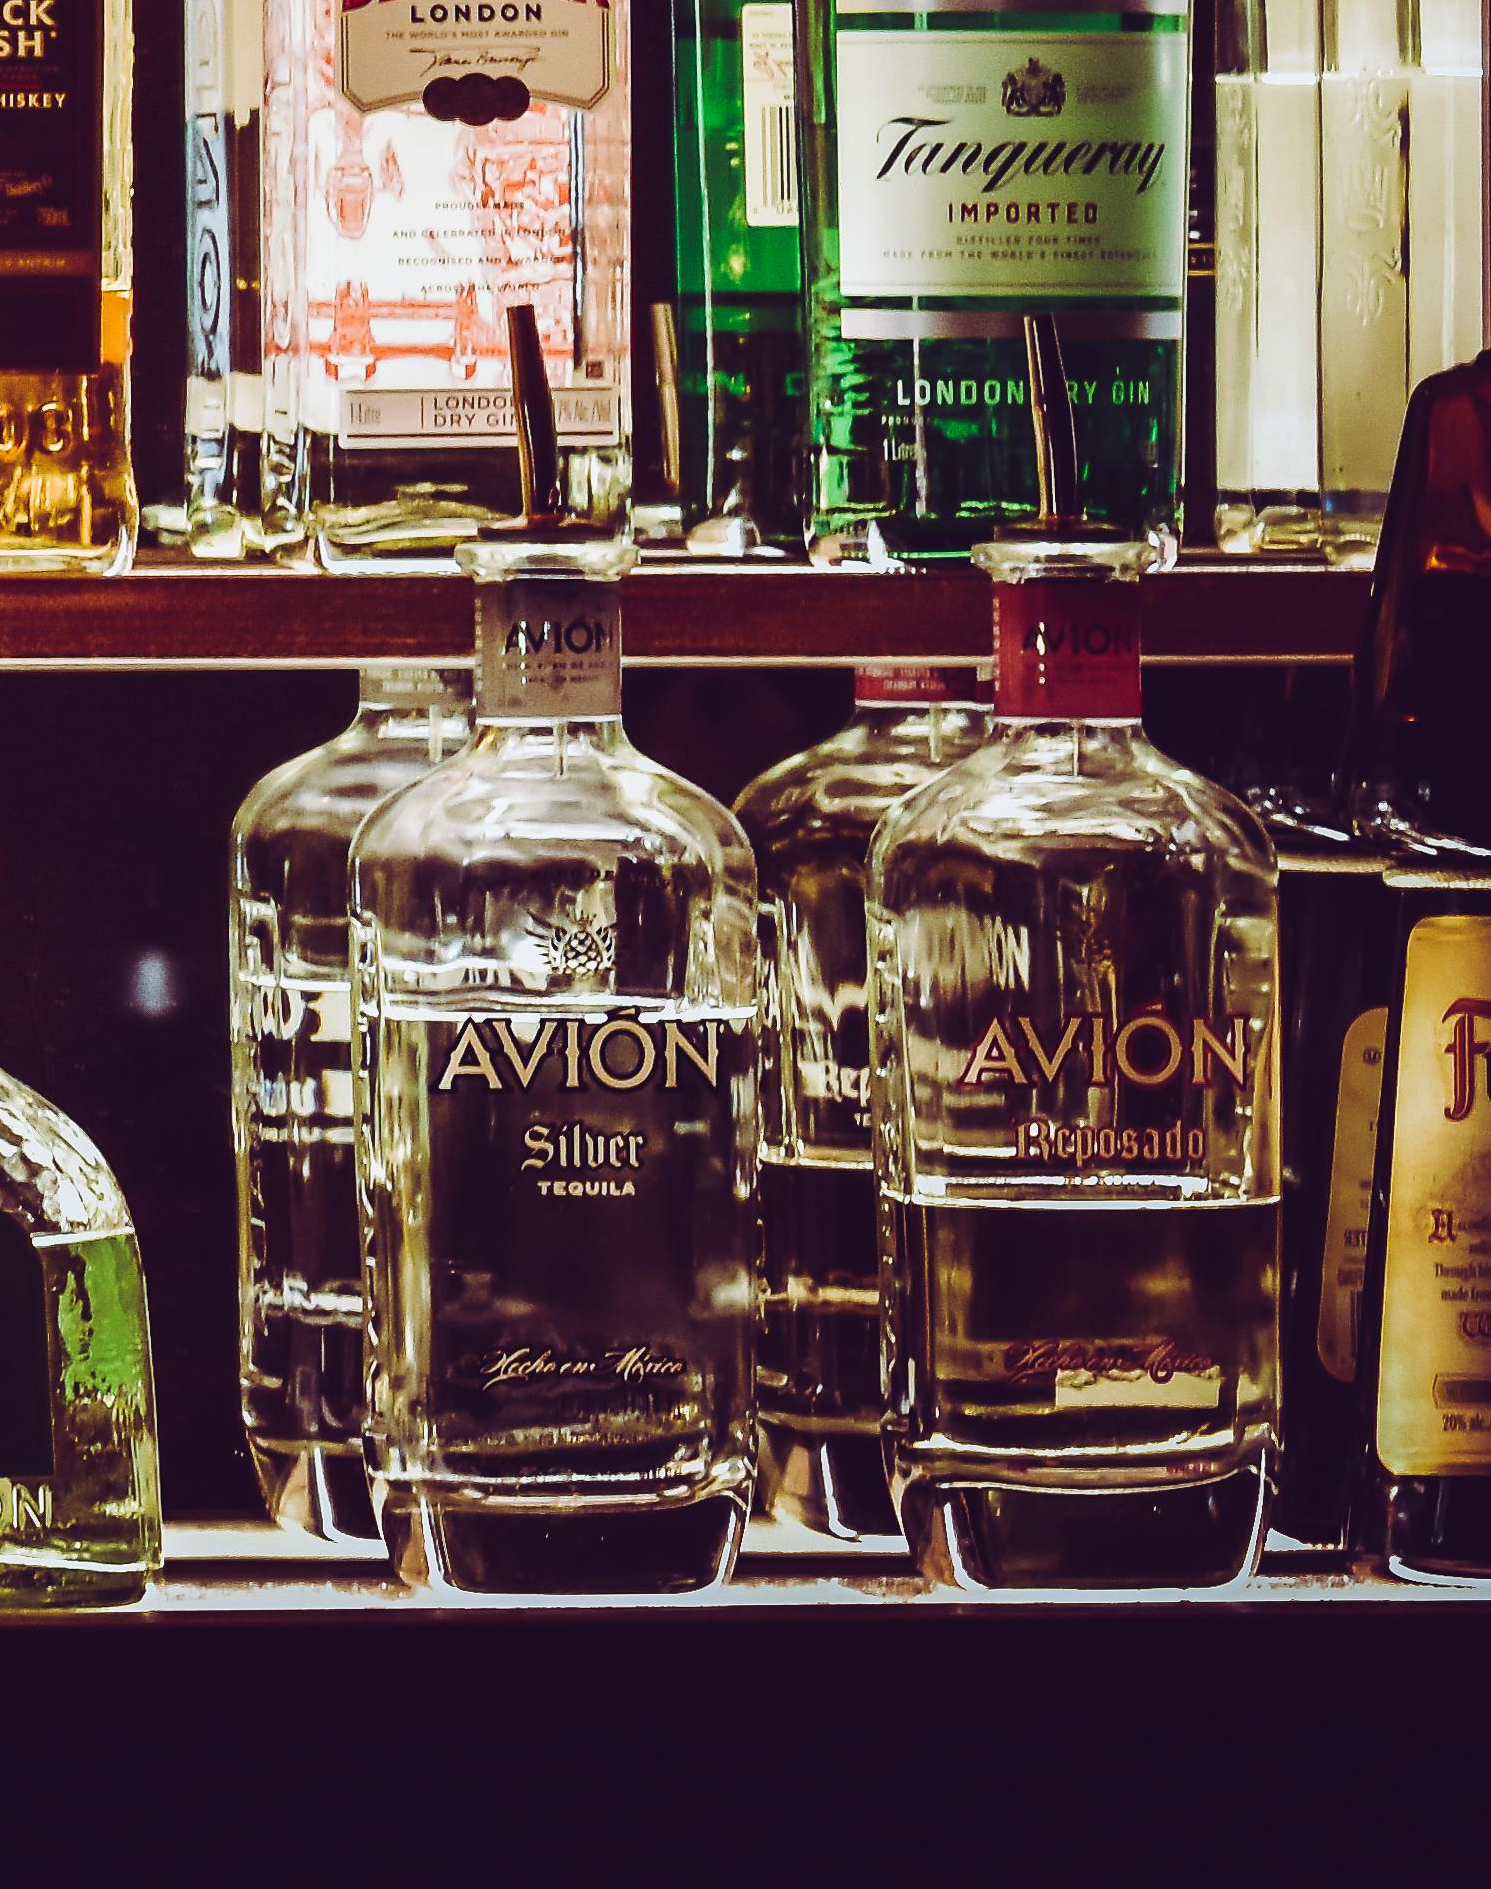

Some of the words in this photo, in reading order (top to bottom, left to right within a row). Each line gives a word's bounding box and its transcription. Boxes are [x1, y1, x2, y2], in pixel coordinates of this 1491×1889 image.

[410, 4, 543, 24] LONDON
[876, 117, 1166, 194] Tanqueray
[948, 202, 1099, 224] IMPORTED
[897, 380, 1023, 406] LONDON
[1112, 380, 1151, 405] GIN
[434, 413, 475, 428] DRY
[438, 1008, 722, 1090] AVIÓN
[961, 1001, 1248, 1087] AVIÓN
[521, 1121, 644, 1172] Silver
[1014, 1118, 1206, 1166] Reposado
[538, 1181, 635, 1196] TEQUILA
